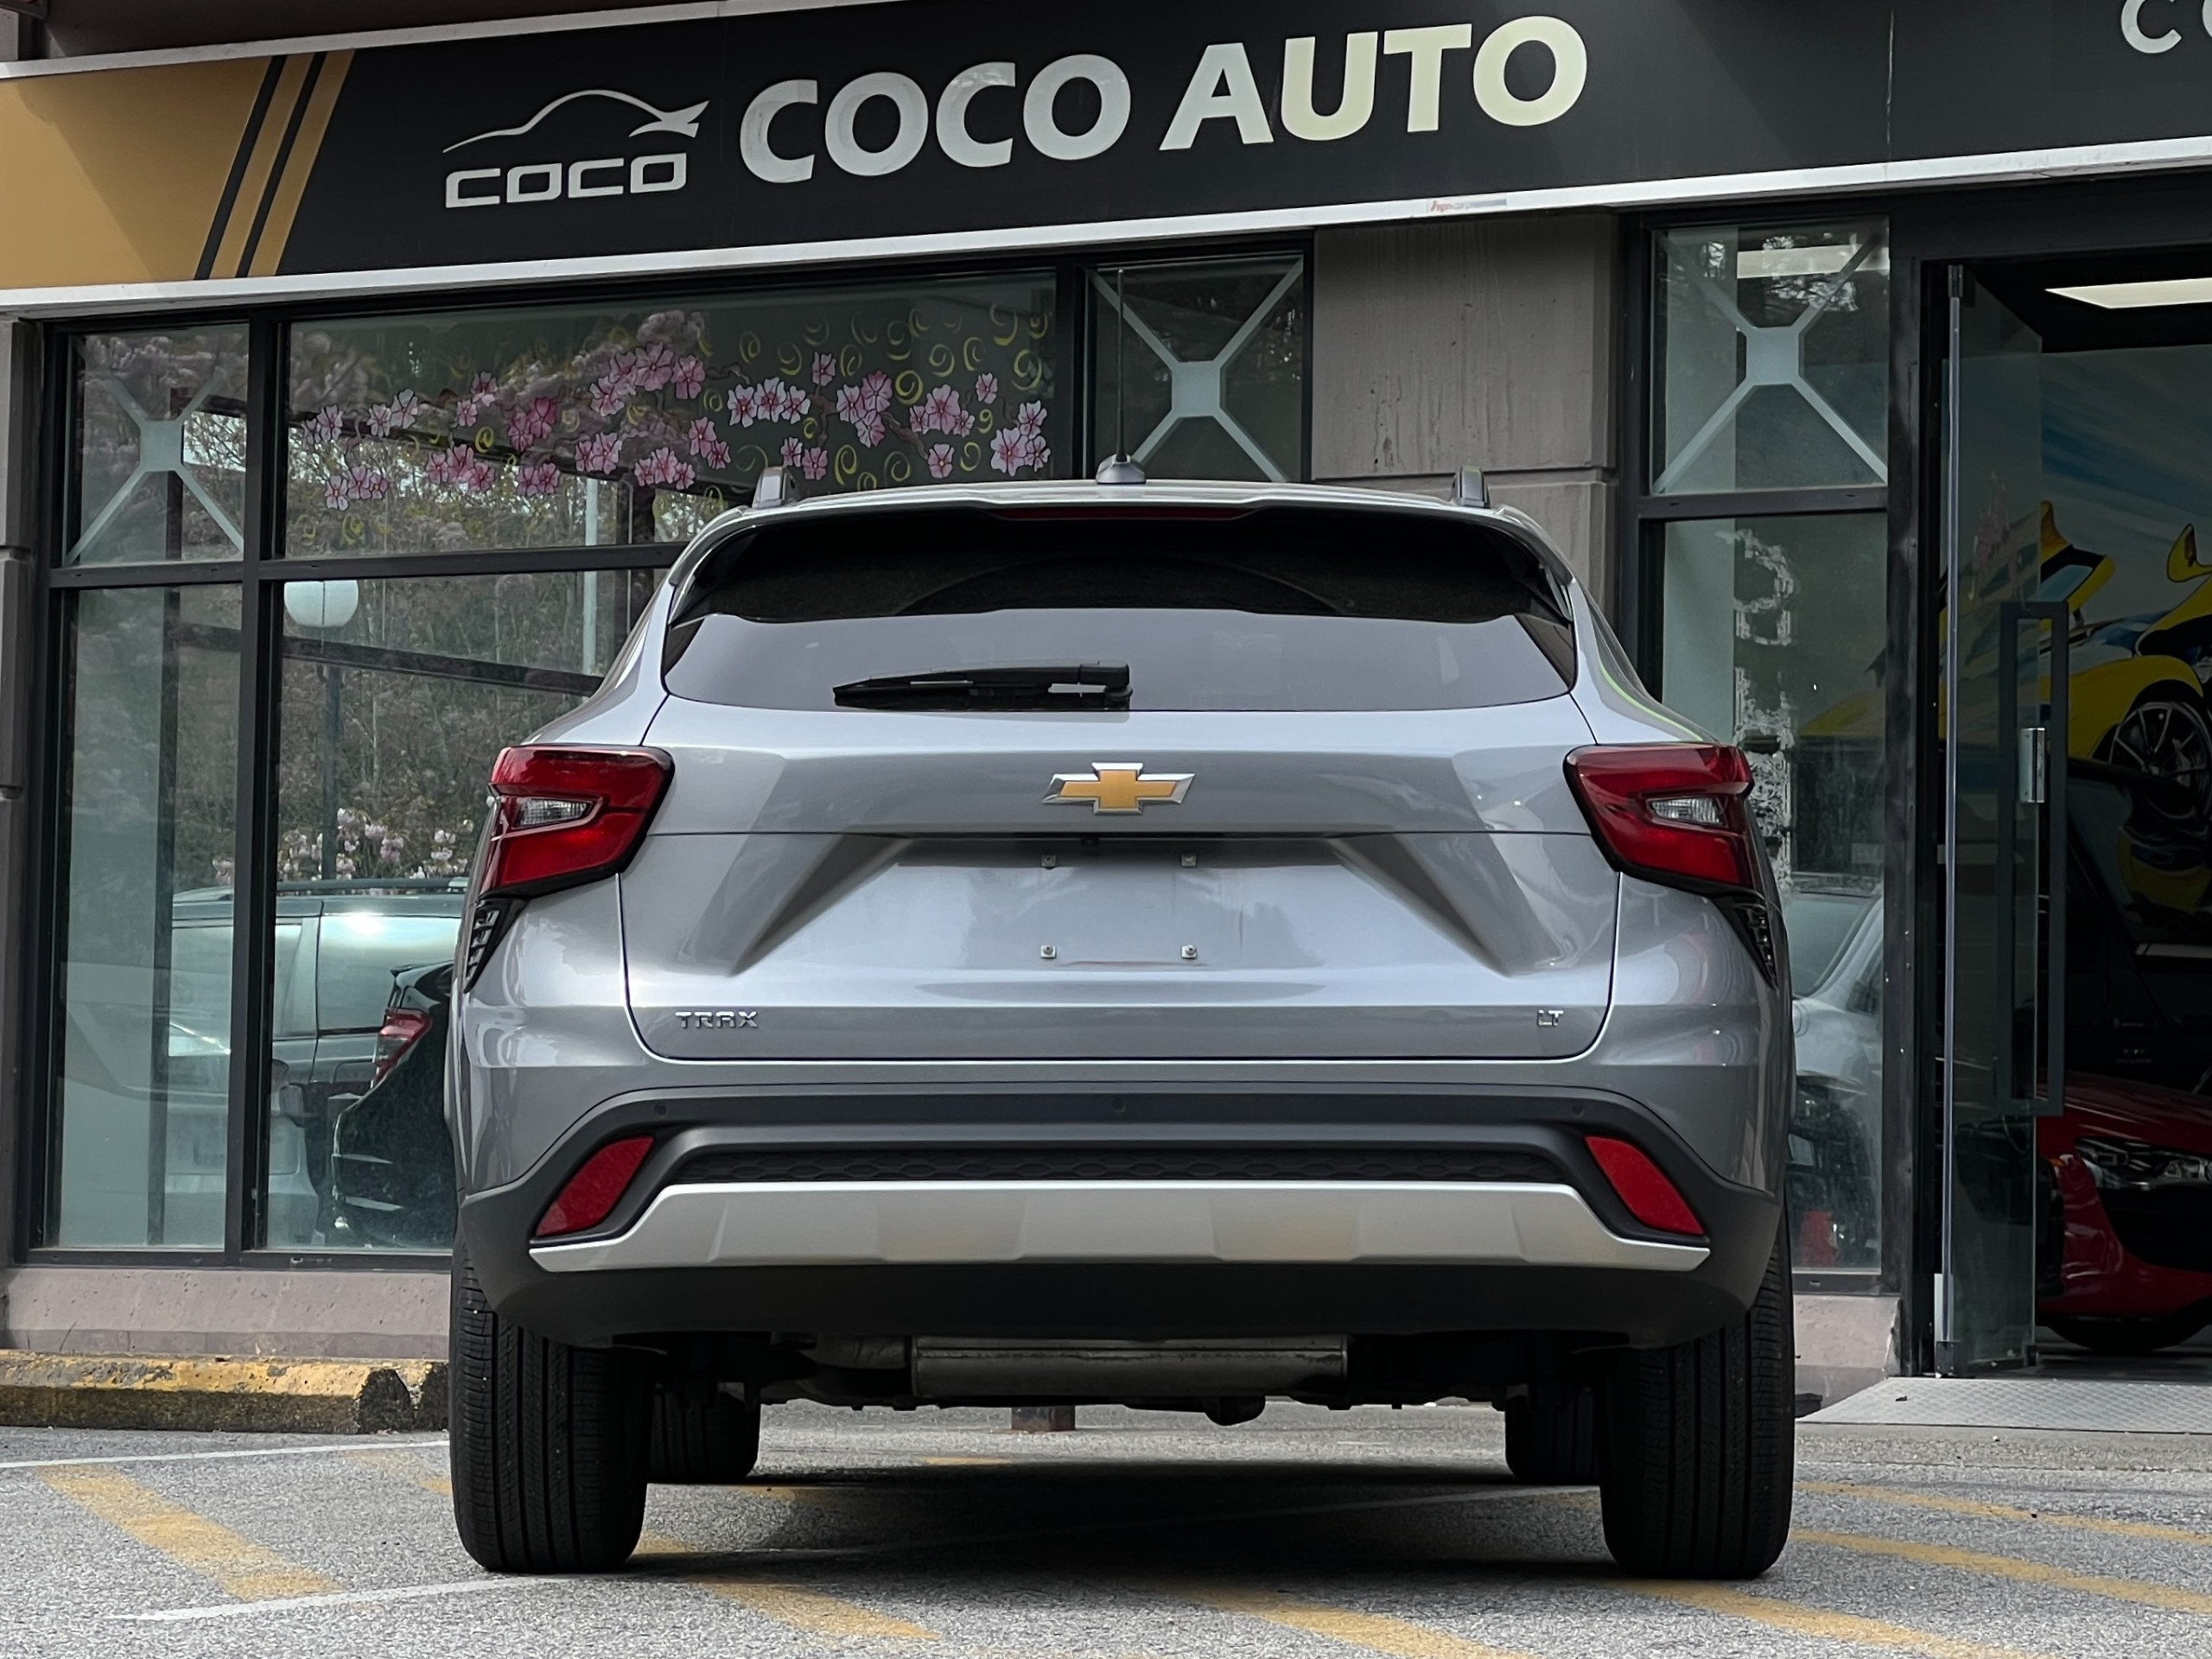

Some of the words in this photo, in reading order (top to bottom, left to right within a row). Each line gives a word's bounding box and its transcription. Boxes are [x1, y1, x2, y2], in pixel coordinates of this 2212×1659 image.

[740, 54, 1131, 183] COCO
[1159, 16, 1588, 151] AUTO
[445, 153, 687, 208] COCO
[675, 1011, 758, 1028] TRAX
[1537, 1009, 1564, 1027] LT
